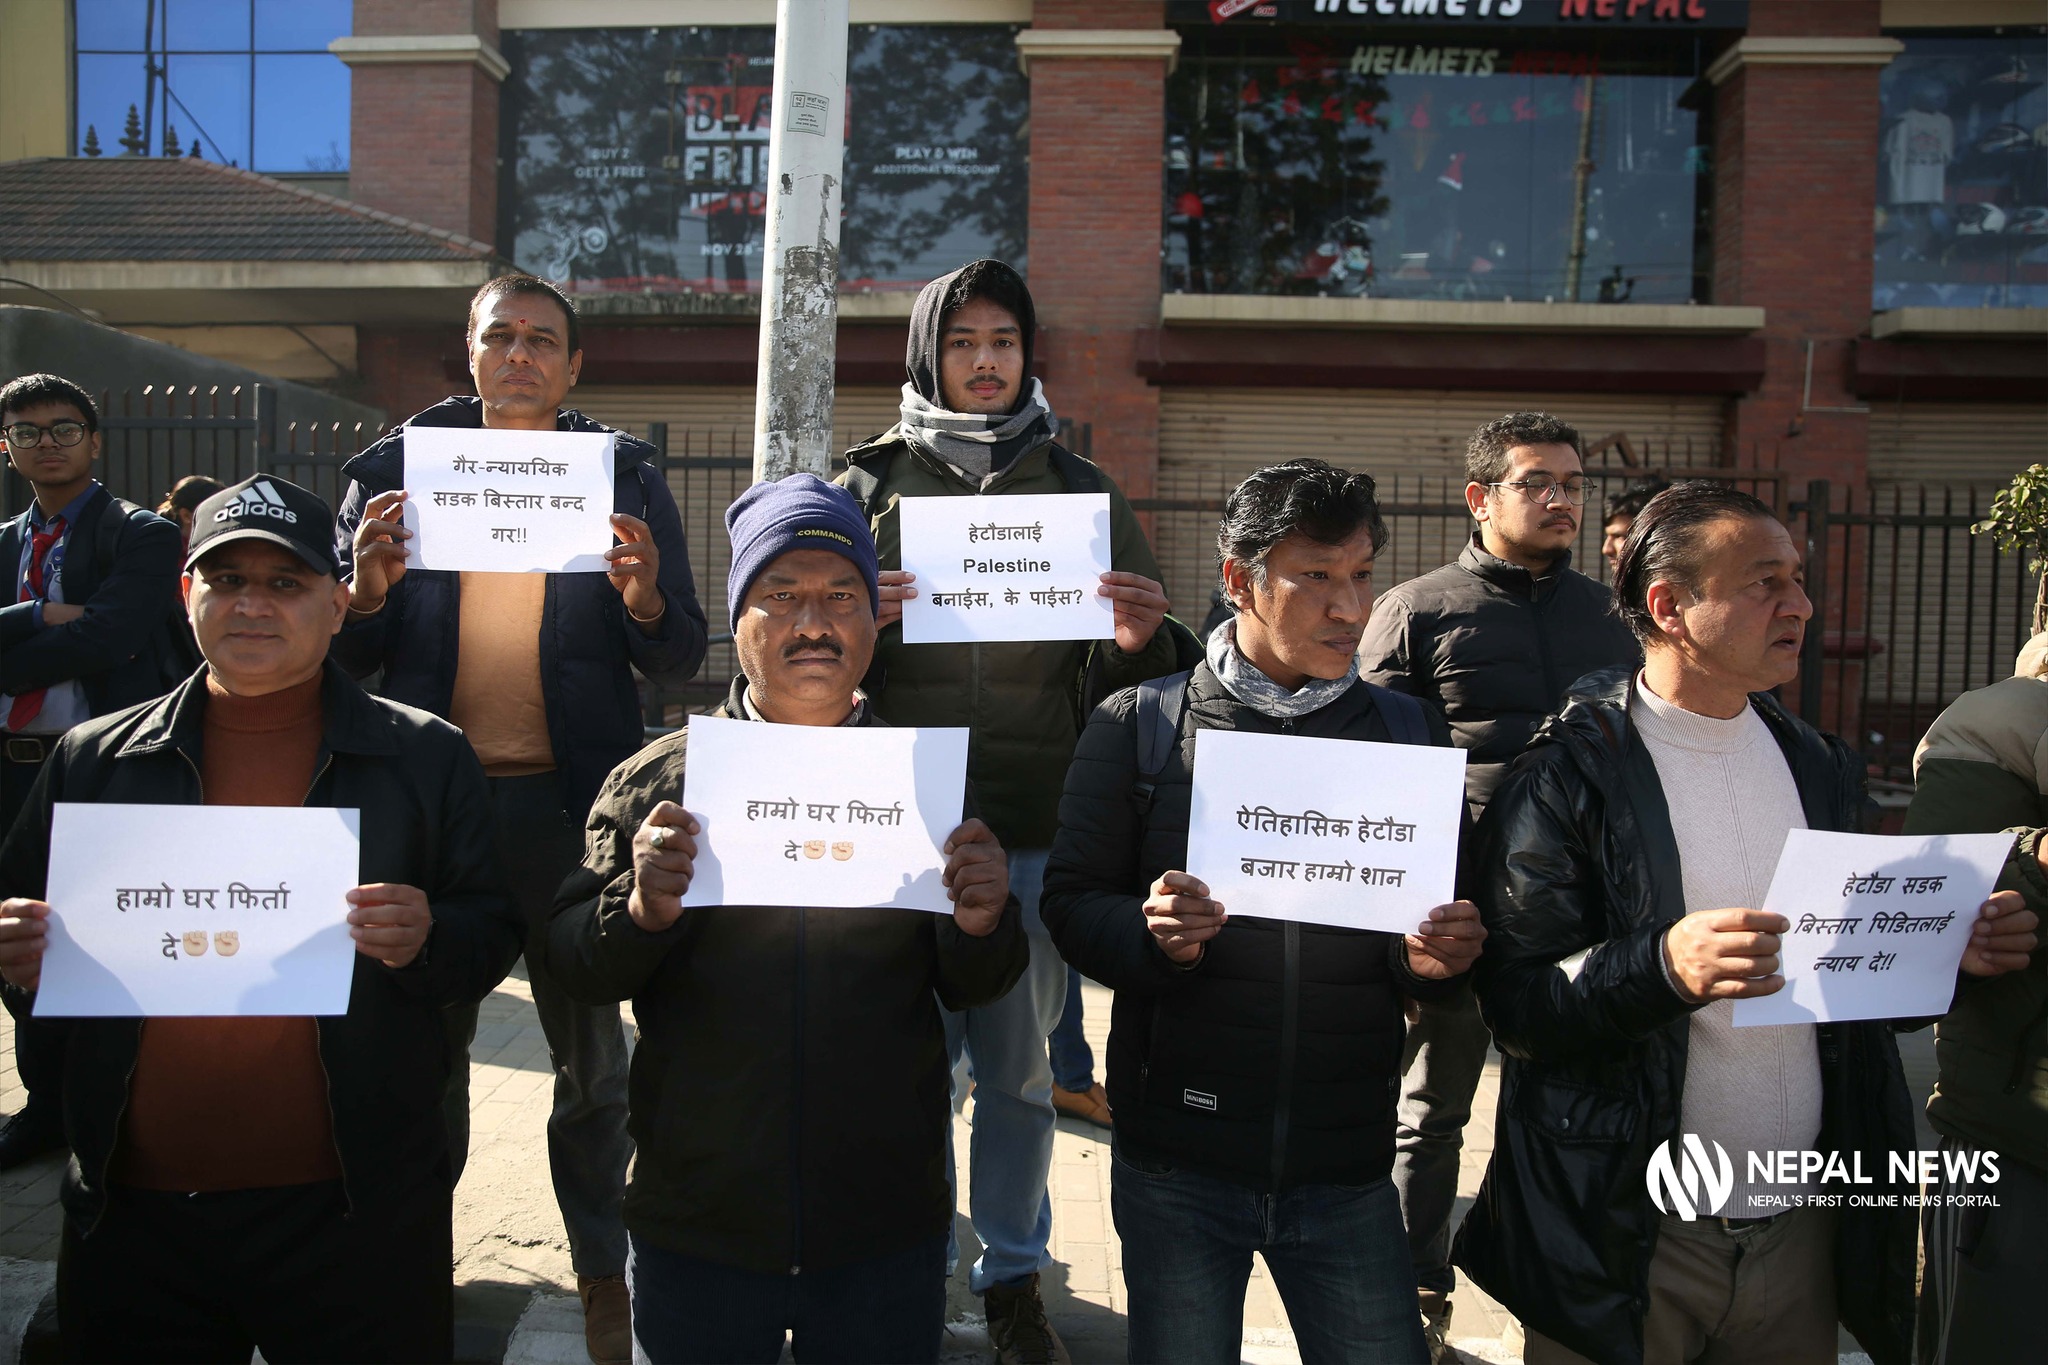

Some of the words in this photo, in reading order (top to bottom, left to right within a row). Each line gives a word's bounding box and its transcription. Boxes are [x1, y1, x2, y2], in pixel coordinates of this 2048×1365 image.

[1351, 47, 1498, 77] HELMETS
[592, 147, 620, 159] BUY
[894, 147, 932, 159] PLAY
[946, 147, 978, 159] WIN
[574, 166, 601, 178] GET
[613, 165, 646, 178] FREE
[452, 454, 569, 477] गैर-न्याययिक
[433, 491, 478, 507] सडक
[483, 488, 545, 510] बिस्तार
[550, 494, 587, 512] बन्द
[213, 502, 298, 524] adidas
[491, 527, 527, 544] गर!!
[968, 520, 1044, 543] हेटौडालाई
[963, 557, 1051, 573] Palestine
[931, 588, 994, 609] बनाईस,
[1004, 588, 1020, 605] के
[1029, 586, 1084, 608] पाईस?
[747, 797, 800, 821] हाम्रो
[807, 803, 840, 823] घर
[847, 799, 905, 826] फिर्ता
[1236, 805, 1353, 838] ऐतिहासिक
[1357, 815, 1417, 843] हेटौडा
[1240, 857, 1300, 880] बजार
[1305, 860, 1355, 883] हाम्रो
[1360, 867, 1407, 888] शान
[1843, 871, 1897, 897] हेटौडा
[1902, 875, 1947, 895] सडक
[116, 882, 175, 912] हाम्रो
[183, 889, 220, 911] घर
[227, 882, 292, 911] फिर्ता
[1794, 912, 1863, 935] बिस्तार
[1867, 910, 1956, 935] पिडितलाई
[1812, 955, 1865, 973] न्याय
[1869, 950, 1897, 973] दे!!
